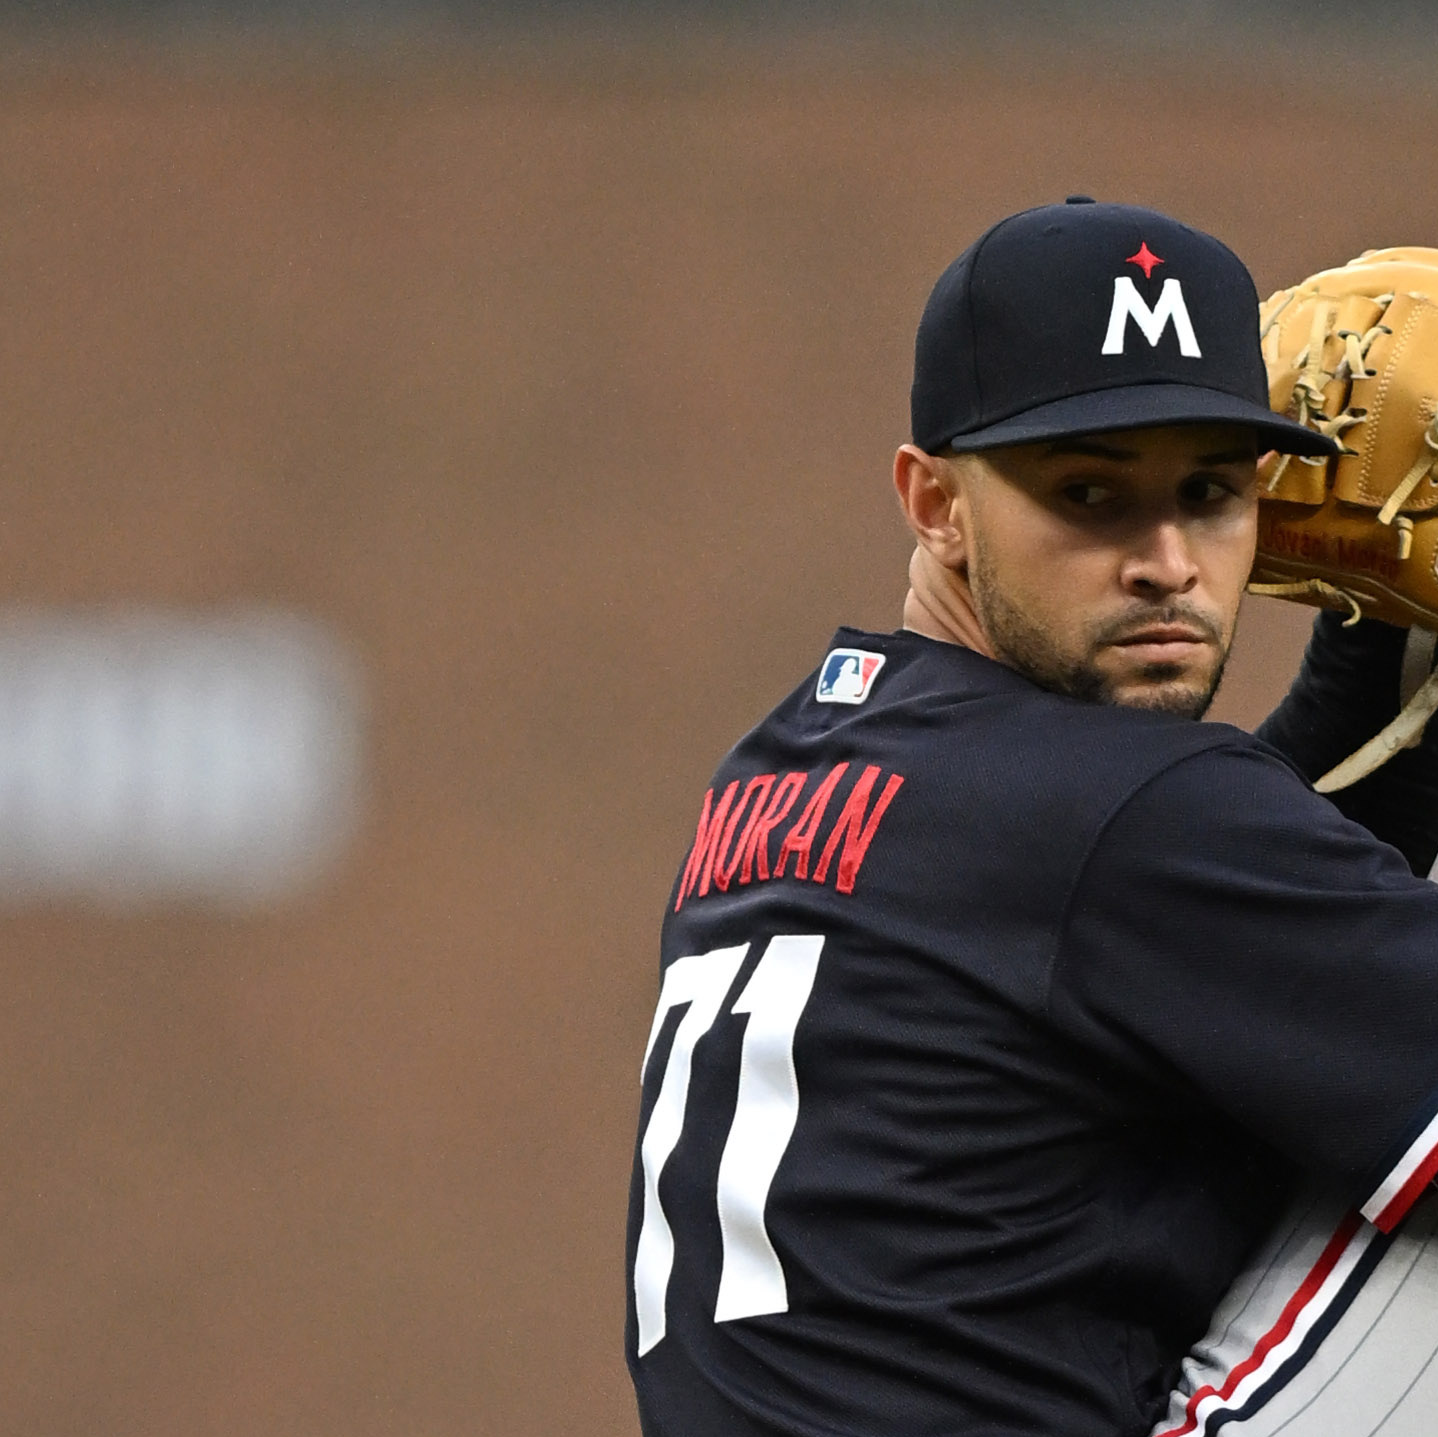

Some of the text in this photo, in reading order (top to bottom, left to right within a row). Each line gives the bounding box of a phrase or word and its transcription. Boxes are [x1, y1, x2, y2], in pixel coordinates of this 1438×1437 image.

[1101, 276, 1202, 359] M
[675, 762, 904, 913] MORAN
[638, 934, 825, 1358] 71
